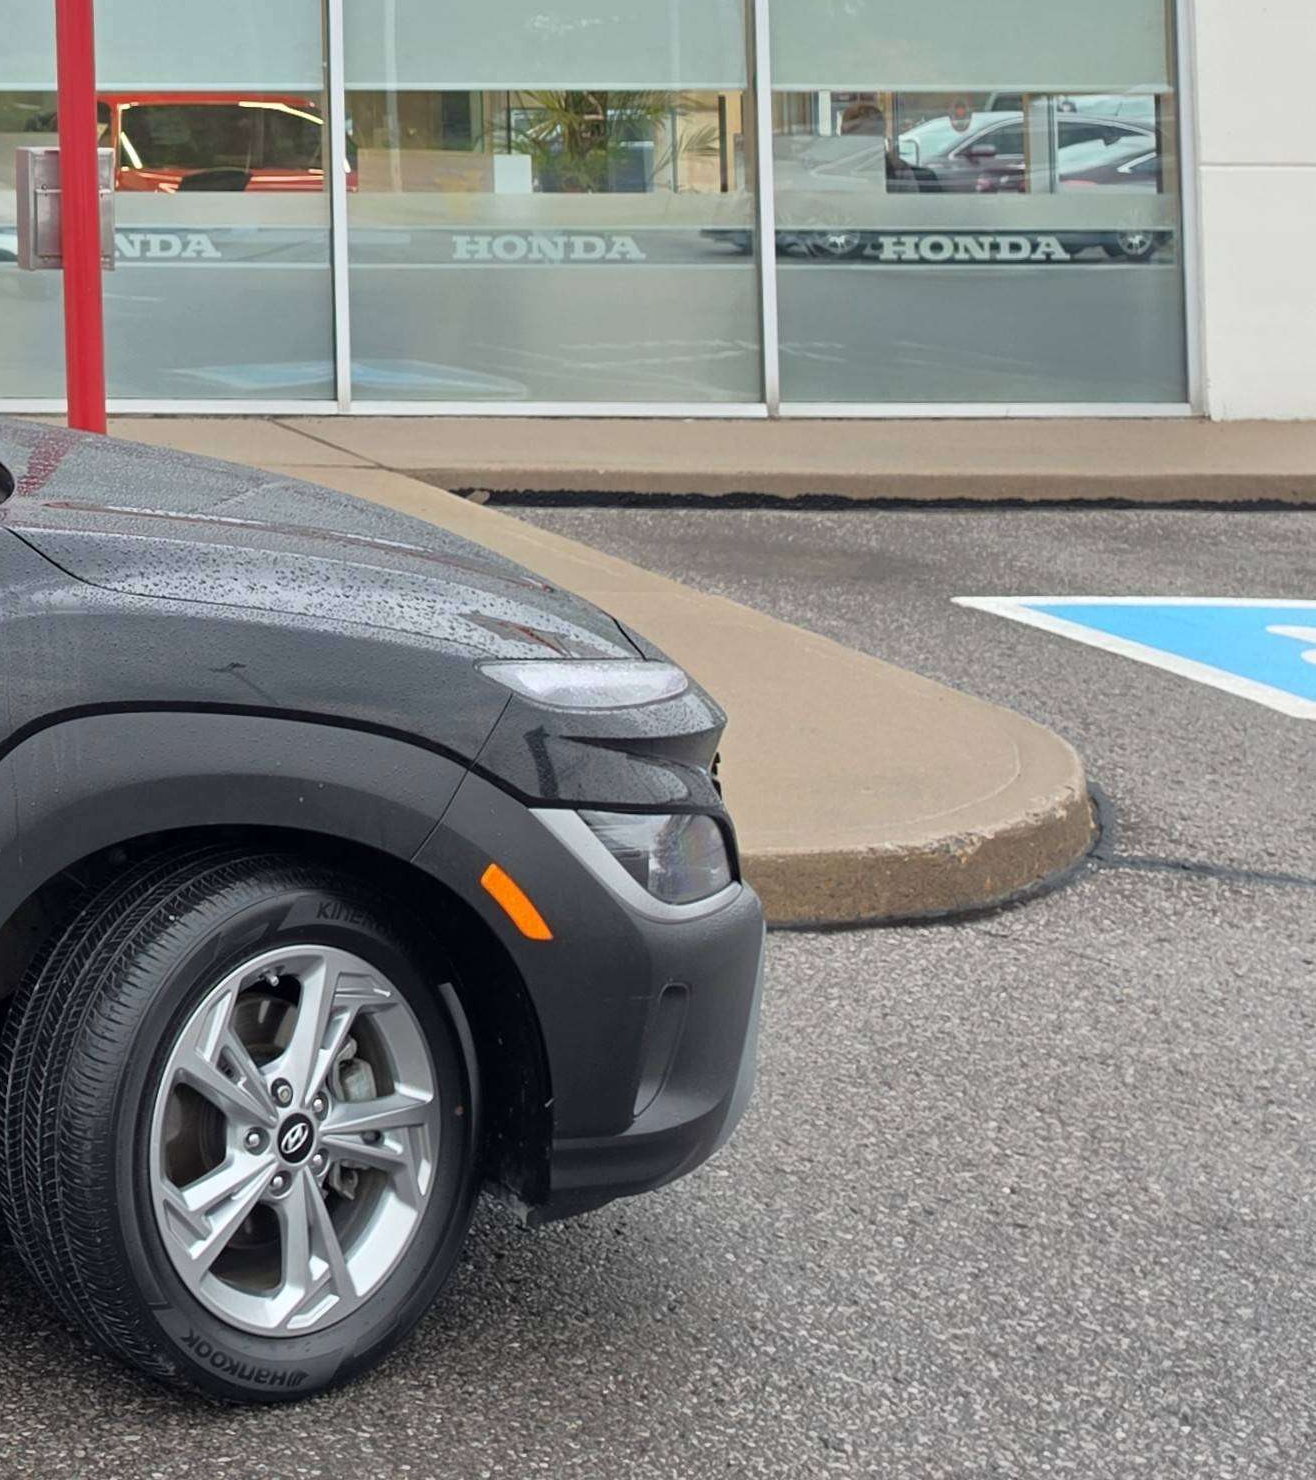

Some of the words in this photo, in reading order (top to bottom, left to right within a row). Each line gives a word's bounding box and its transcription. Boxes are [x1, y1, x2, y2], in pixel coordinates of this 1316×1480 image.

[114, 233, 222, 258] NDA
[452, 234, 647, 261] HONDA
[878, 234, 1070, 261] HONDA
